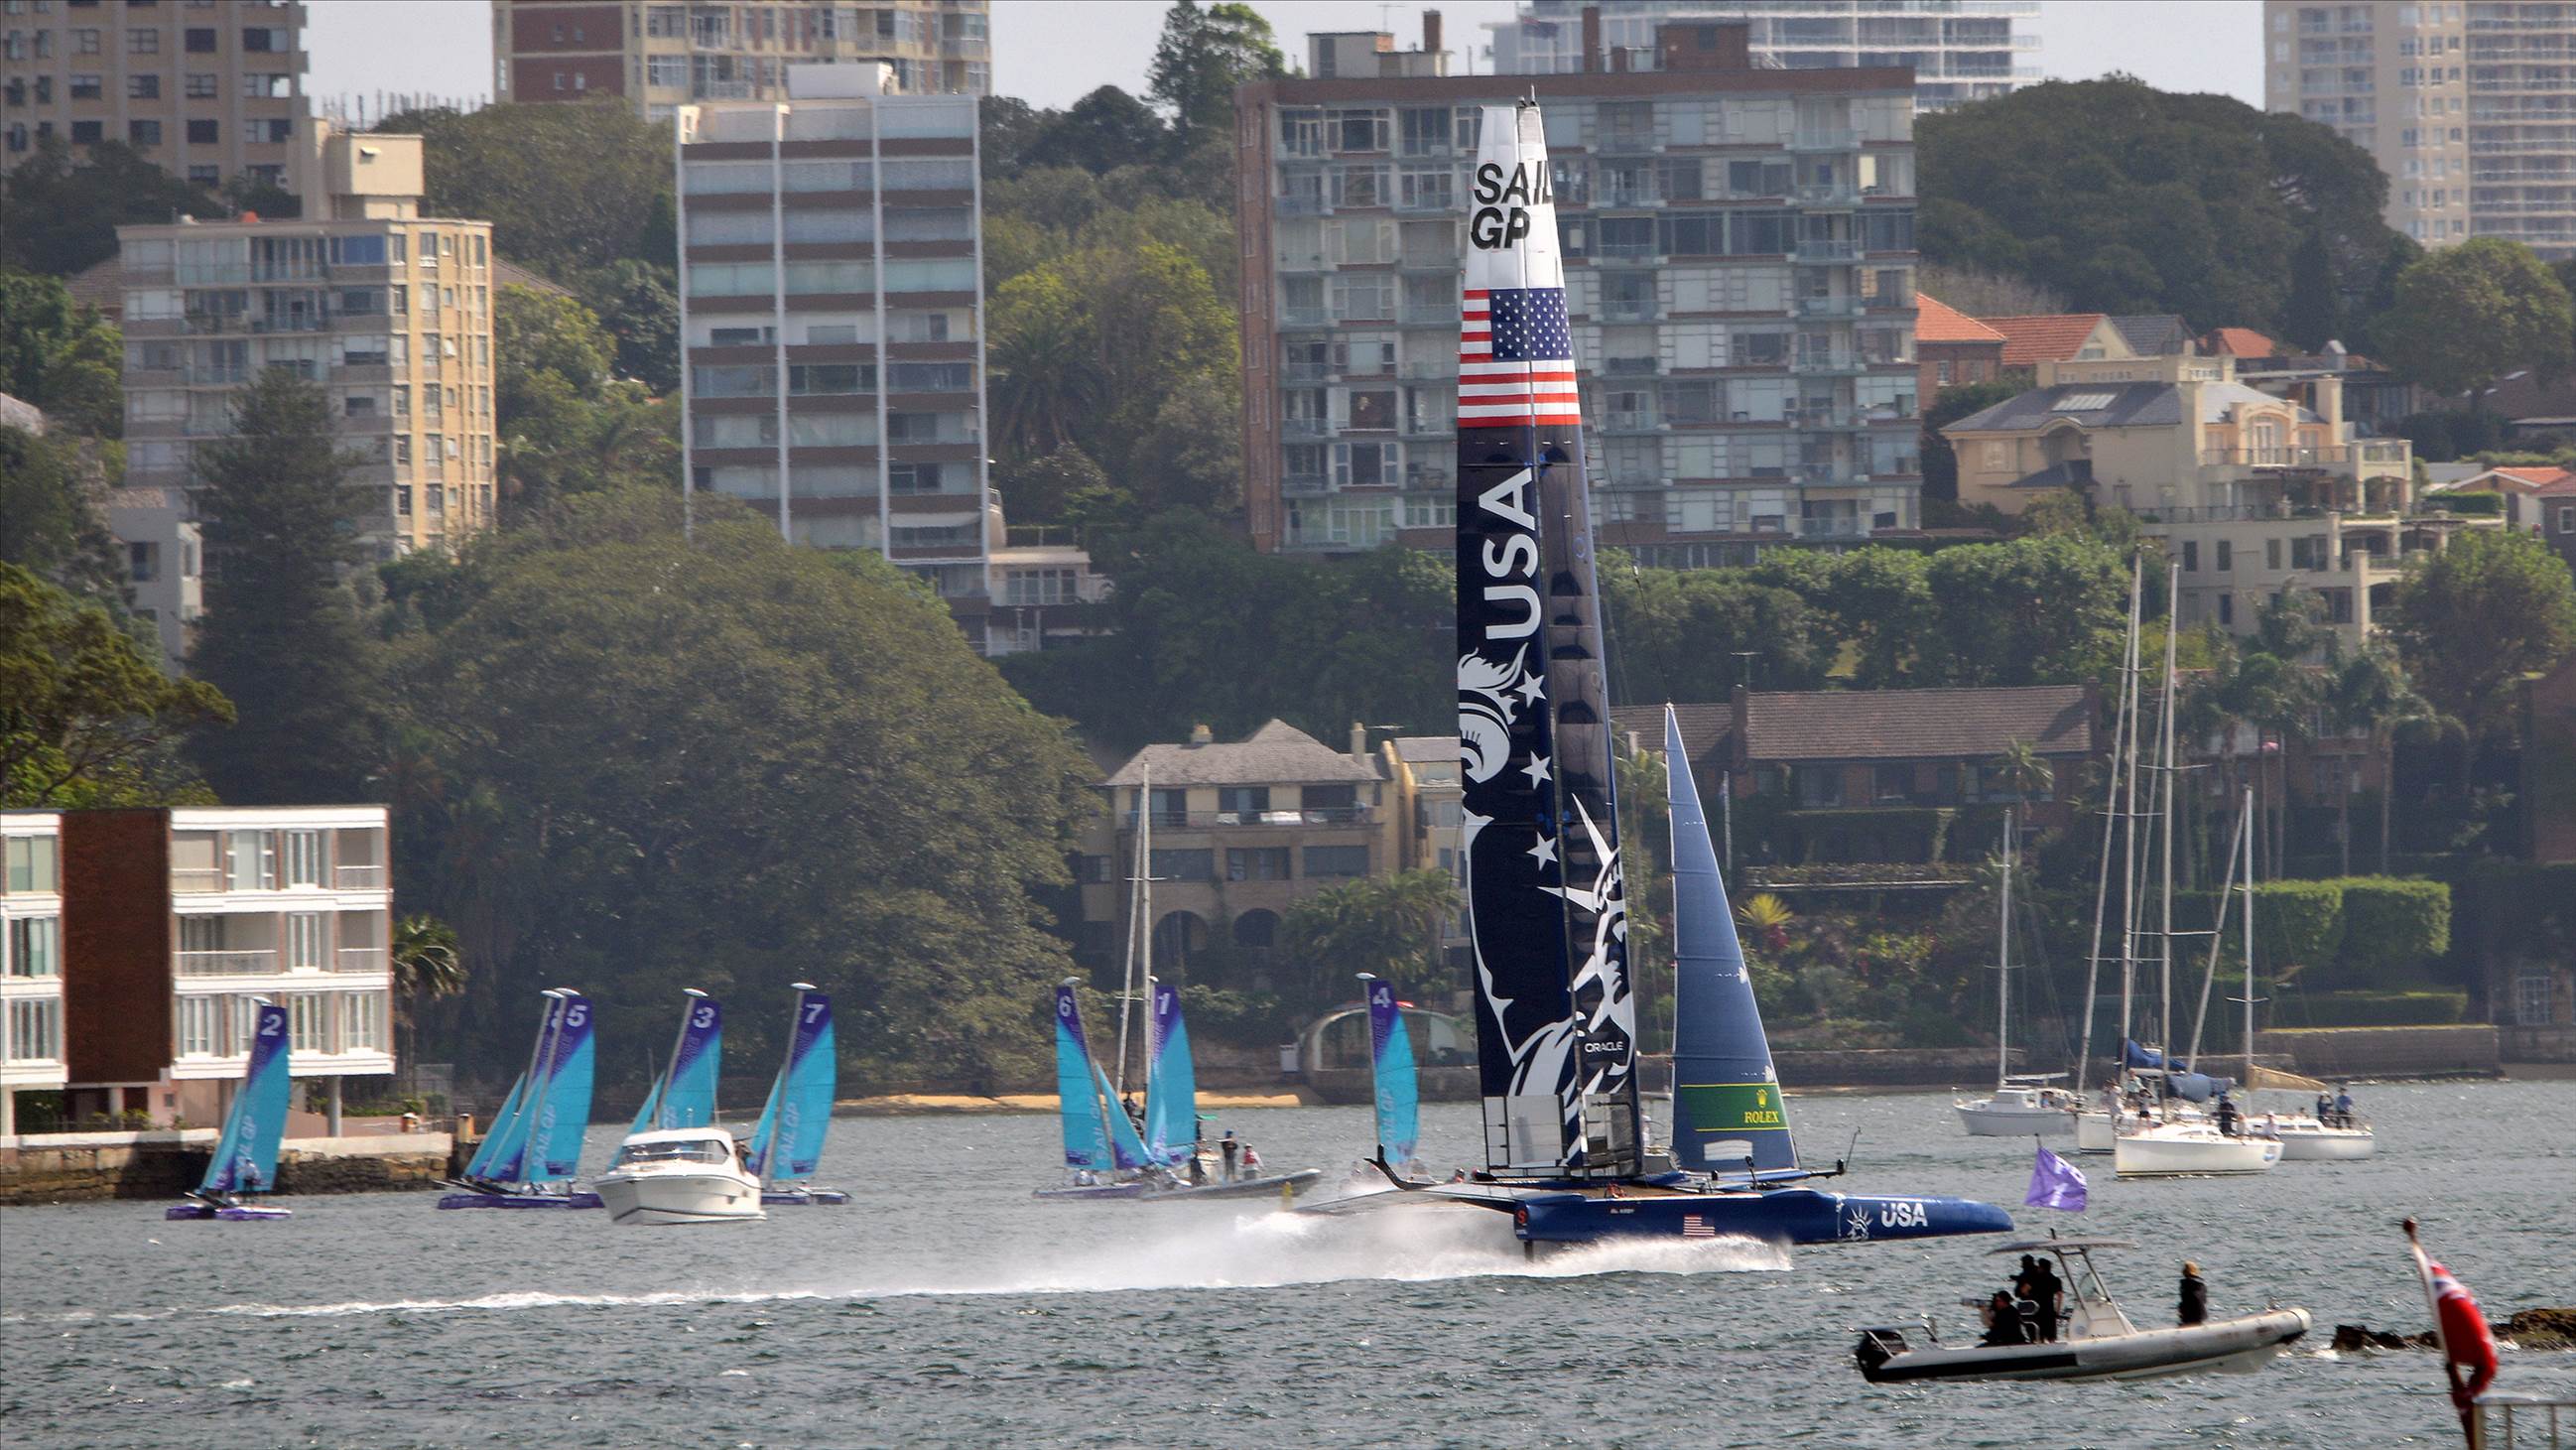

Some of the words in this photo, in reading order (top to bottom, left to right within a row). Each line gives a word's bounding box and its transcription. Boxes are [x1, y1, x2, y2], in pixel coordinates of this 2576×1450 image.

[1474, 160, 1554, 206] SAIL
[1471, 206, 1530, 250] GP
[1479, 467, 1541, 640] USA
[1058, 994, 1073, 1017] 6
[1158, 992, 1171, 1015] 1
[1372, 987, 1391, 1007] 4
[261, 1013, 282, 1036] 2
[566, 1004, 587, 1027] 5
[693, 1006, 715, 1028] 3
[805, 1003, 826, 1024] 7
[1584, 1041, 1624, 1053] ORACLE
[1744, 1111, 1779, 1123] ROLEX
[1880, 1202, 1928, 1228] USA
